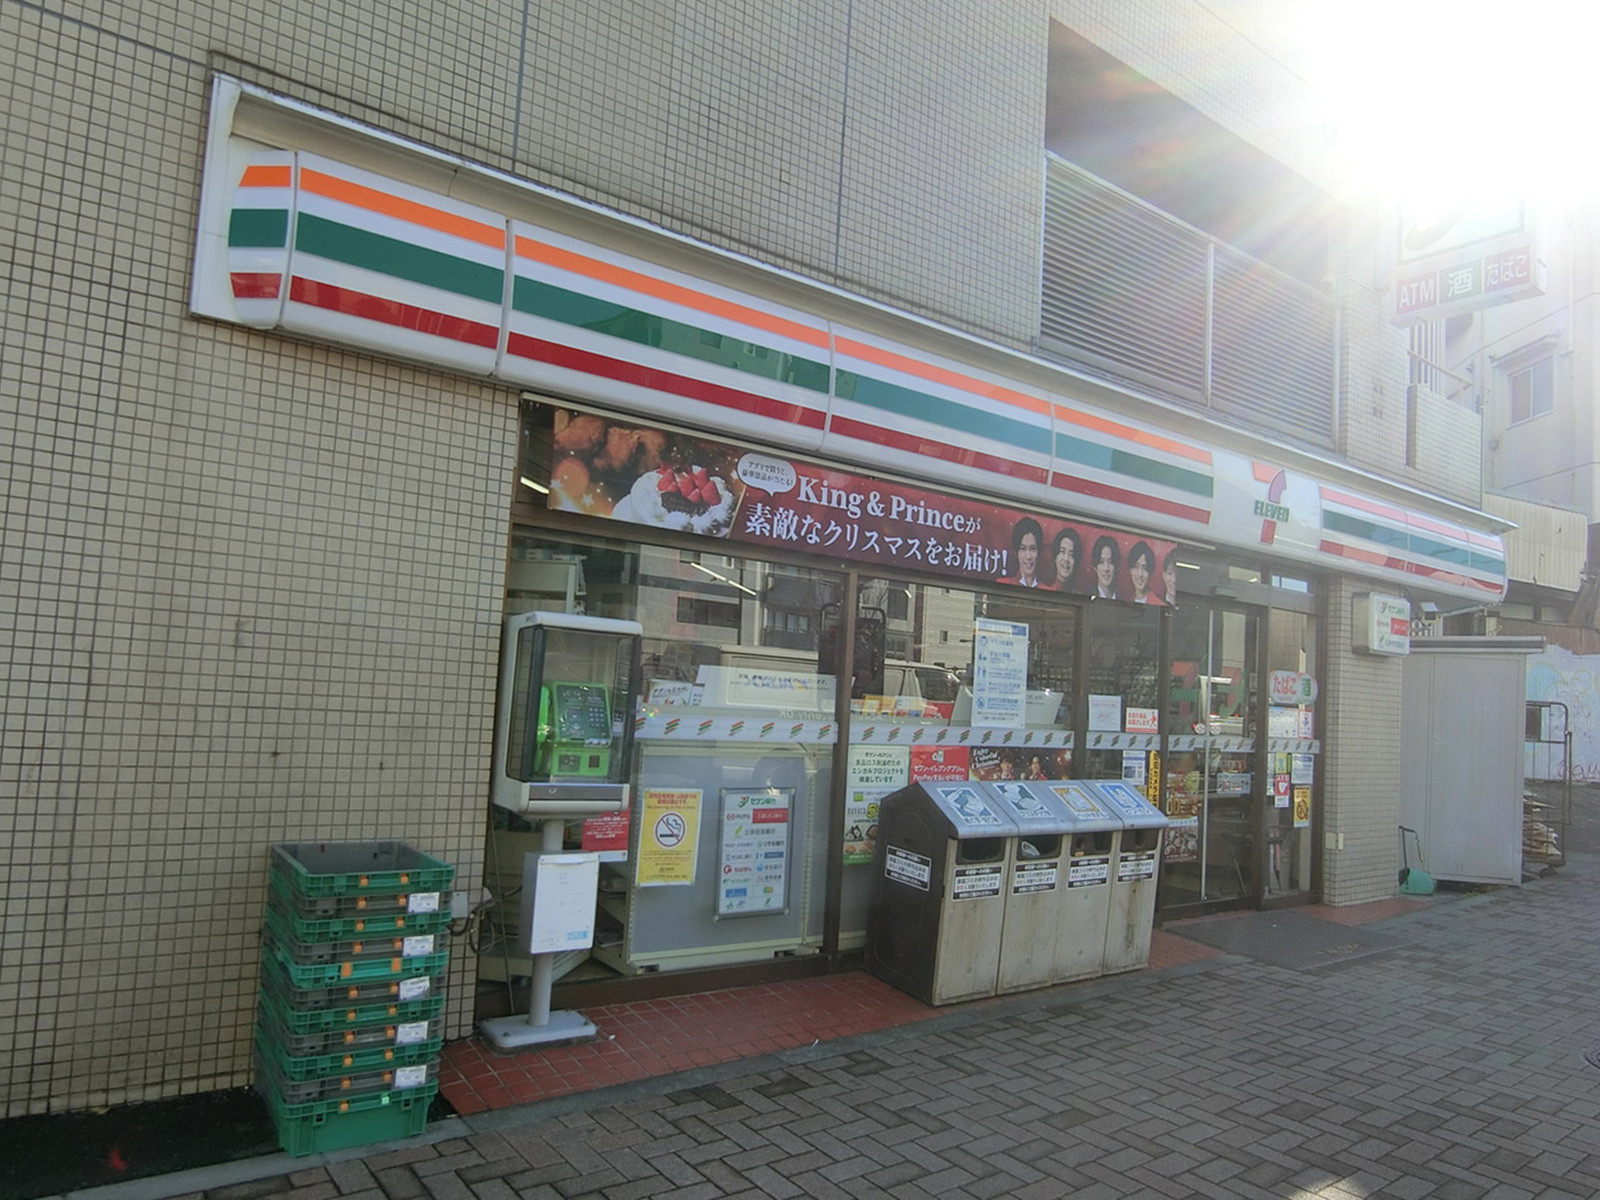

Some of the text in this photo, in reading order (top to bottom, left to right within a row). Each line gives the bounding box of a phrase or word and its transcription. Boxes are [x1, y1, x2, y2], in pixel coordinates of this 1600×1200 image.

[1447, 267, 1473, 298] 酒
[1486, 254, 1528, 287] たばこ
[1399, 278, 1435, 308] ATM
[797, 475, 864, 519] King
[866, 490, 886, 517] &
[745, 502, 1008, 576] 素敵なクリスマスをお届け!
[1273, 675, 1297, 695] たばこ
